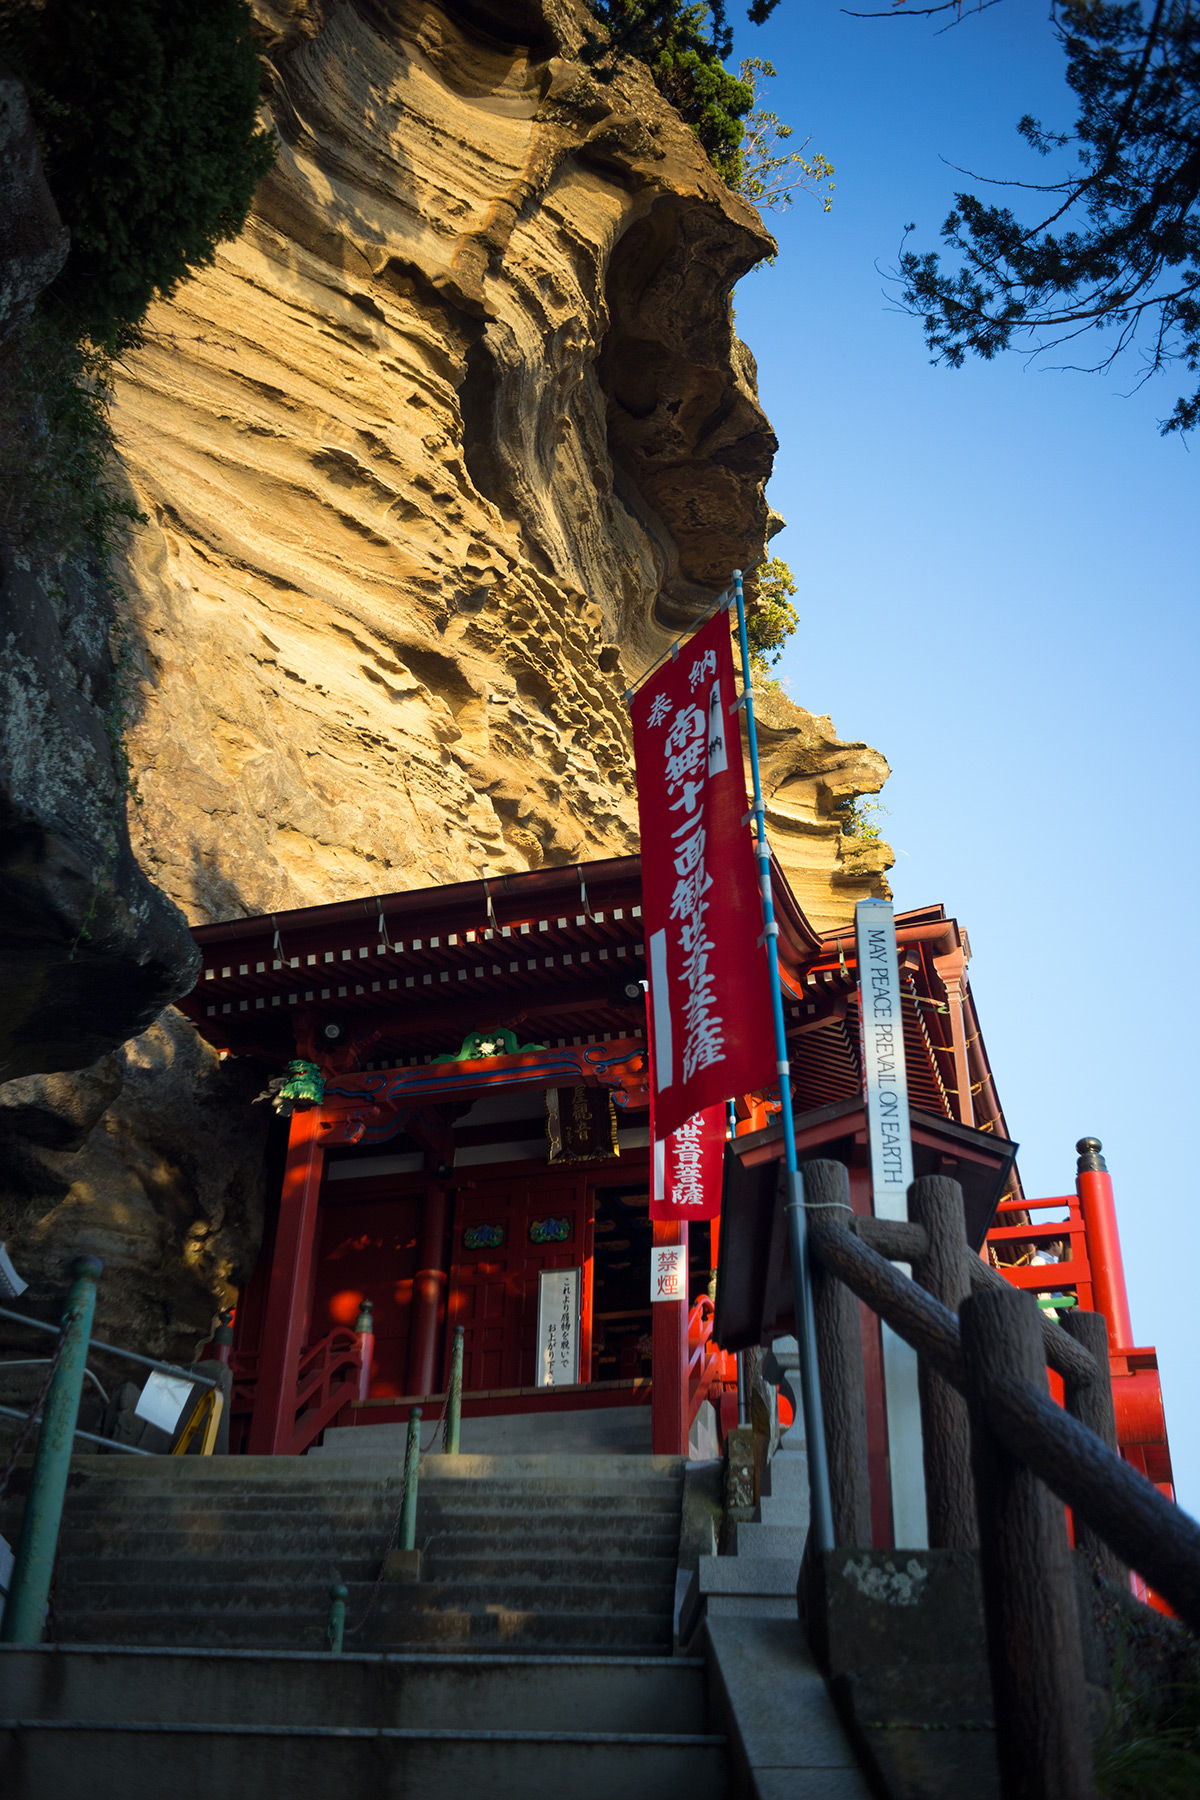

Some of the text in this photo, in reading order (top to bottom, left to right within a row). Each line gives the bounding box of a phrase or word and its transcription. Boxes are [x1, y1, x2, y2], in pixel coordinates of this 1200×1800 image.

[867, 929, 903, 1184] MAY PEACE PREVAIL ON EARTH
[657, 1251, 679, 1296] 禁煙
